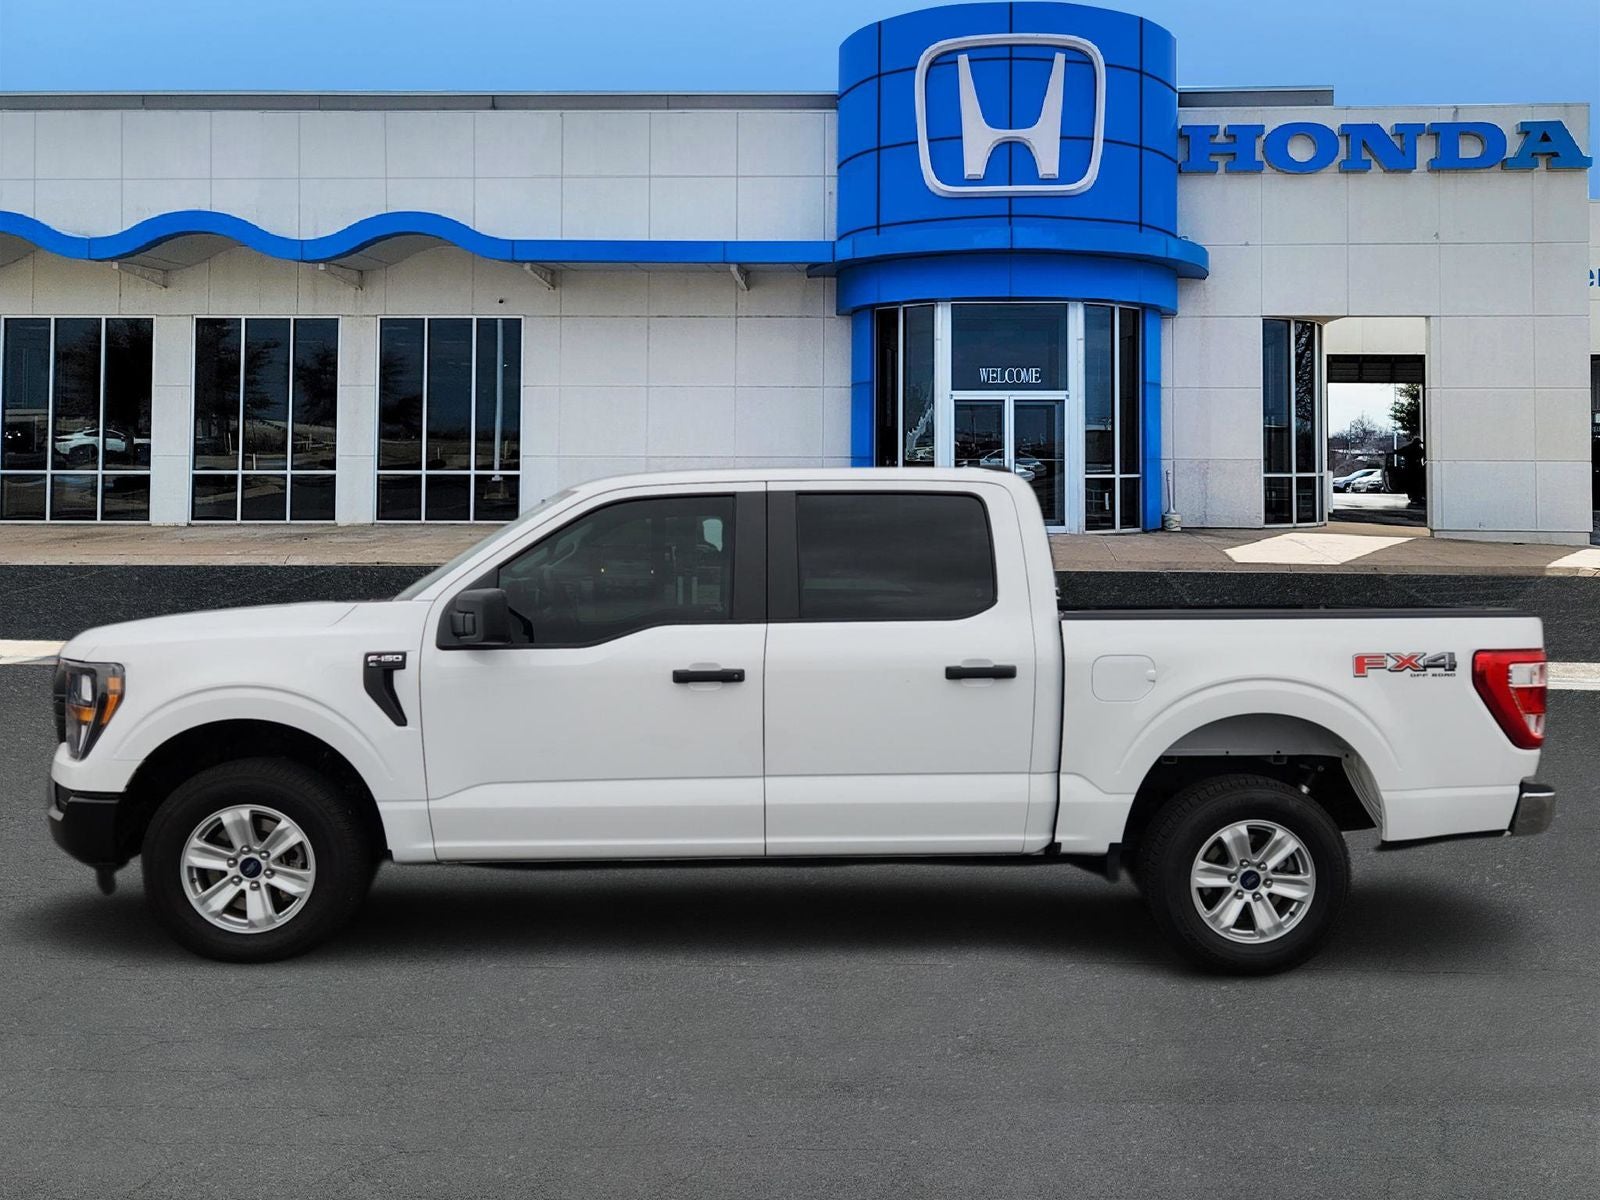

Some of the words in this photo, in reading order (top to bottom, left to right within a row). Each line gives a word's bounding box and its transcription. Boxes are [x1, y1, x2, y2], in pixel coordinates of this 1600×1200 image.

[1178, 119, 1593, 175] HONDA
[979, 367, 1042, 384] WELCOME
[367, 654, 403, 662] F-150
[1352, 652, 1457, 678] FX4
